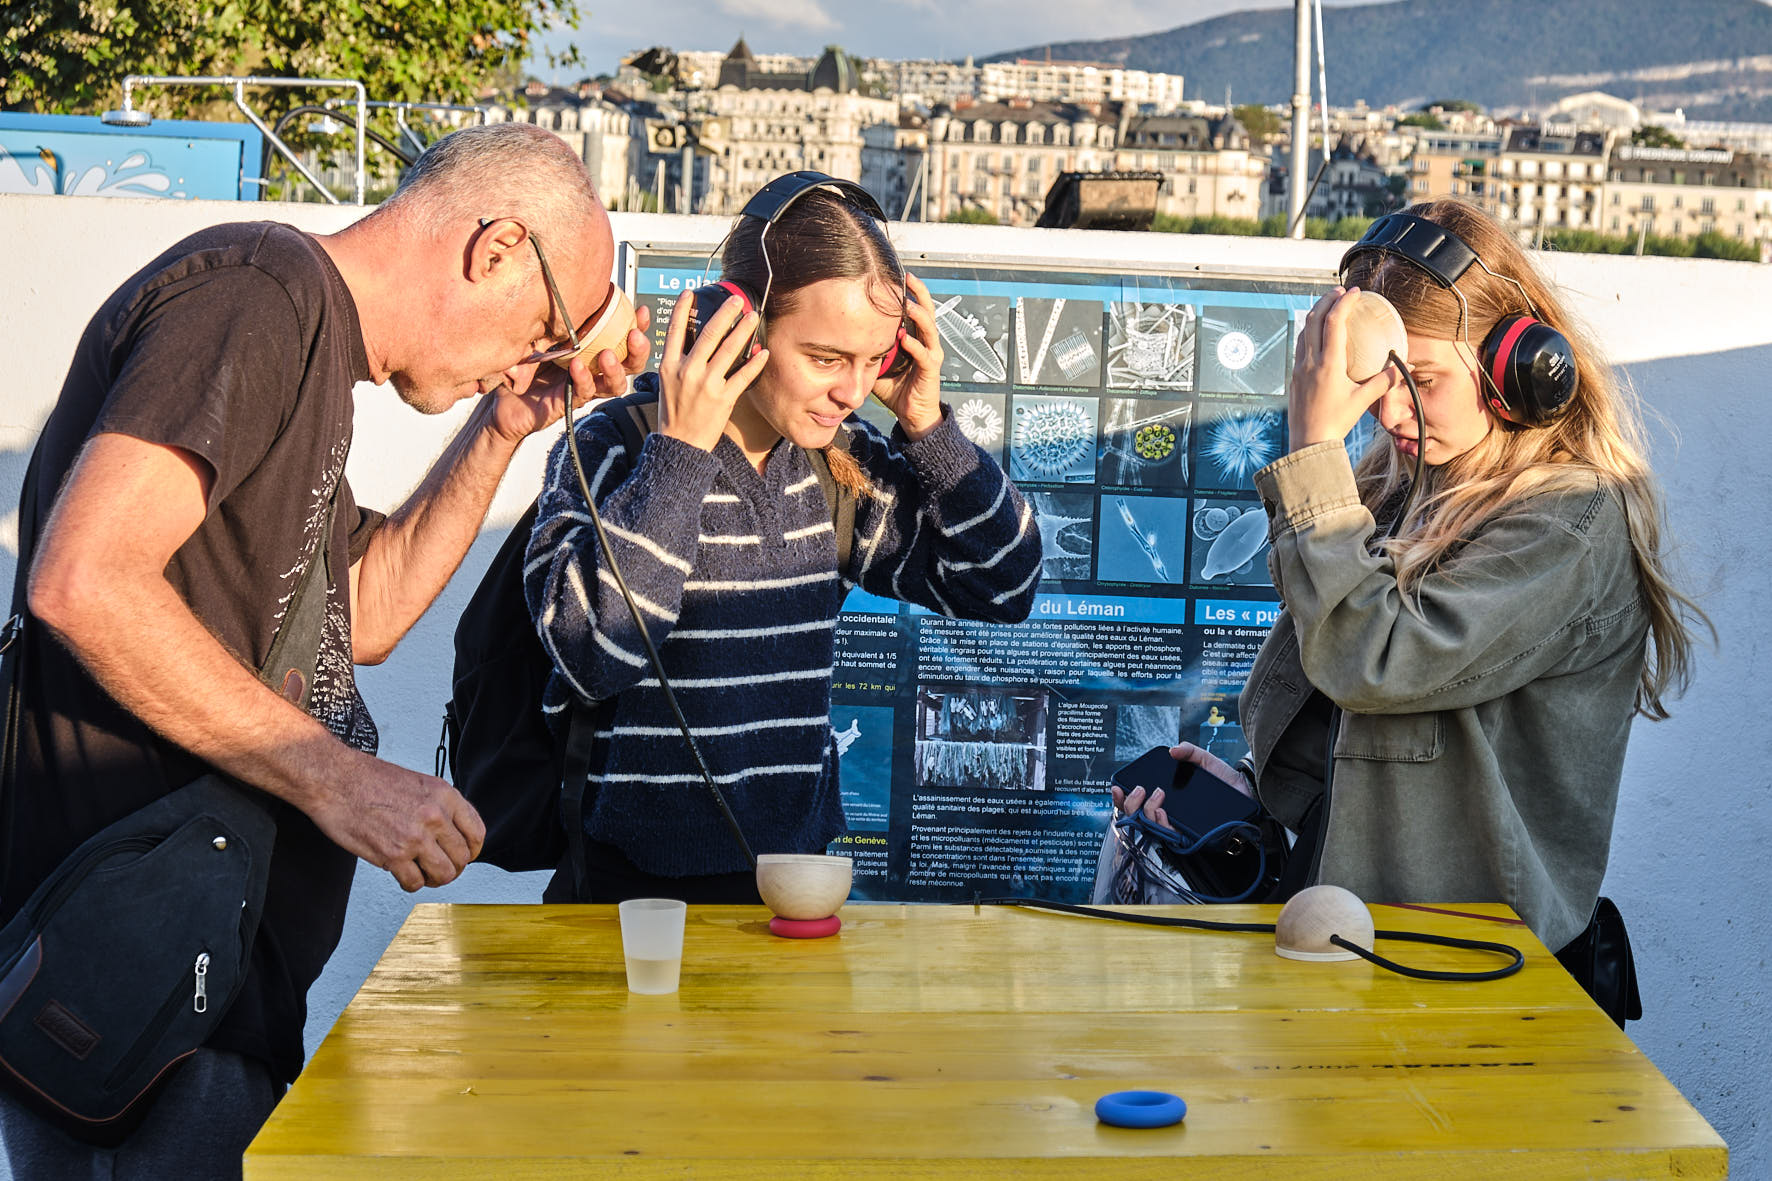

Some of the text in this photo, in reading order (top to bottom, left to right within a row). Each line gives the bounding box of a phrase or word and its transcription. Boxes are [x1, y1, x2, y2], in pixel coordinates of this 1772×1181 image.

[659, 274, 680, 289] Le
[1040, 600, 1126, 617] du Léman
[842, 614, 896, 624] occidentale!
[1205, 605, 1281, 626] Les « pu
[921, 619, 944, 627] Durant
[946, 619, 956, 627] les
[1014, 622, 1030, 630] suite
[1043, 623, 1062, 631] fortes
[1064, 623, 1096, 634] pollutions
[1098, 624, 1114, 632] liées
[1123, 625, 1150, 633] l'activité
[1217, 628, 1226, 636] la
[854, 629, 887, 638] maximale
[888, 630, 898, 638] de
[920, 627, 932, 635] des
[966, 628, 976, 636] ont
[978, 629, 989, 637] été
[991, 629, 1011, 639] prises
[1013, 632, 1028, 640] pour
[1030, 631, 1062, 639] améliorer
[1072, 632, 1094, 642] qualité
[1096, 633, 1108, 641] des
[920, 636, 940, 644] Grâce
[960, 638, 976, 646] mise
[990, 639, 1008, 649] place
[1022, 640, 1048, 648] stations
[1106, 642, 1131, 652] apports
[1213, 642, 1246, 650] dermatite
[842, 650, 897, 660] équivalent 1/5
[919, 645, 948, 654] véritable
[950, 646, 975, 657] engrais
[977, 649, 993, 657] pour
[1007, 648, 1029, 658] algues
[1040, 649, 1074, 660] provenant
[1076, 650, 1125, 661] principalement
[1202, 650, 1221, 658] C'est
[1236, 651, 1258, 659] affecti
[944, 655, 977, 664] fortement
[1017, 657, 1057, 668] prolifération
[1070, 659, 1101, 667] certaines
[1103, 660, 1126, 670] algues
[1128, 661, 1143, 671] peut
[1145, 661, 1182, 670] néanmoins
[918, 672, 953, 681] diminution
[992, 674, 1028, 685] phosphore
[945, 664, 980, 675] engendrer
[1000, 666, 1034, 674] nuisances
[1045, 667, 1065, 675] raison
[1069, 669, 1084, 678] pour
[1088, 668, 1114, 679] laquelle
[1131, 670, 1153, 678] efforts
[1156, 672, 1172, 681] pour
[846, 682, 856, 690] les
[858, 682, 868, 690] 72
[884, 684, 896, 692] qui
[842, 836, 888, 845] de Genève,
[854, 850, 888, 858] traitement
